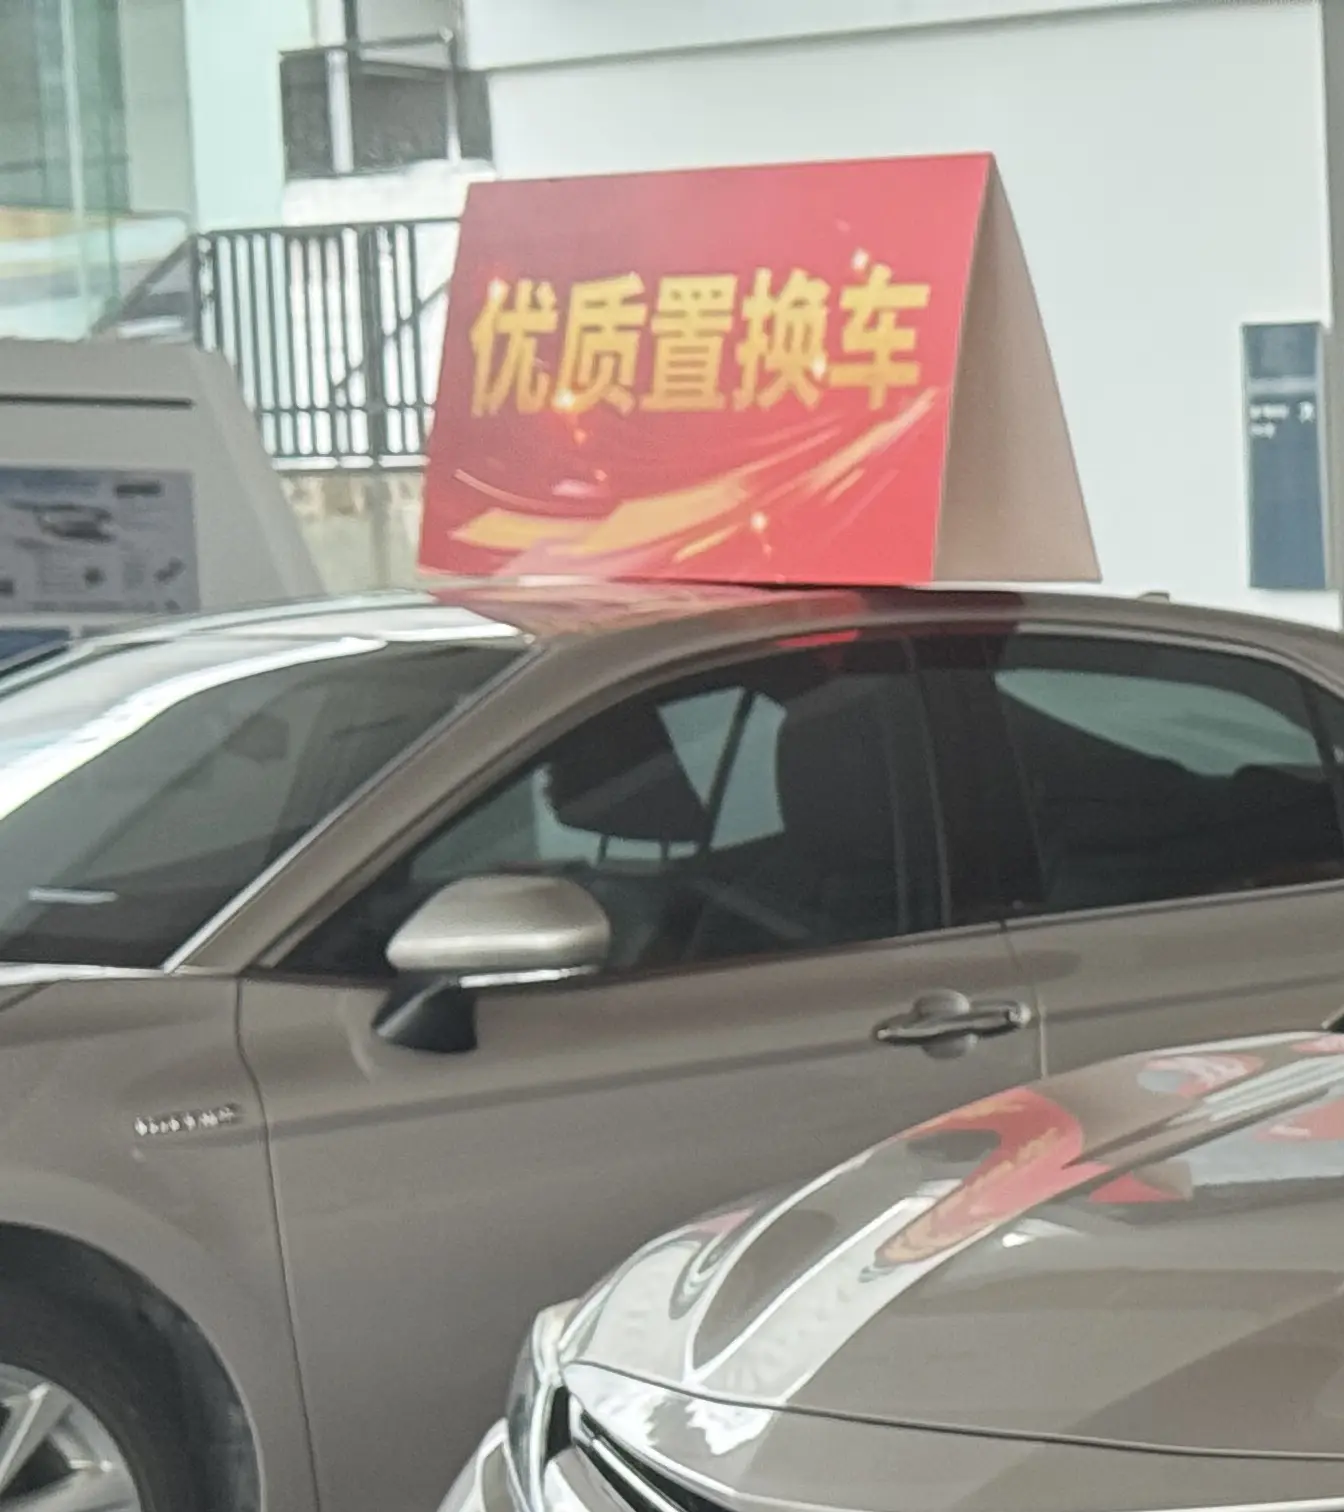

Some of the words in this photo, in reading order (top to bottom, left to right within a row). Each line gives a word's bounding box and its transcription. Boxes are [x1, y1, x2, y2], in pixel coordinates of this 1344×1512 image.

[469, 263, 931, 418] 优质置换车
